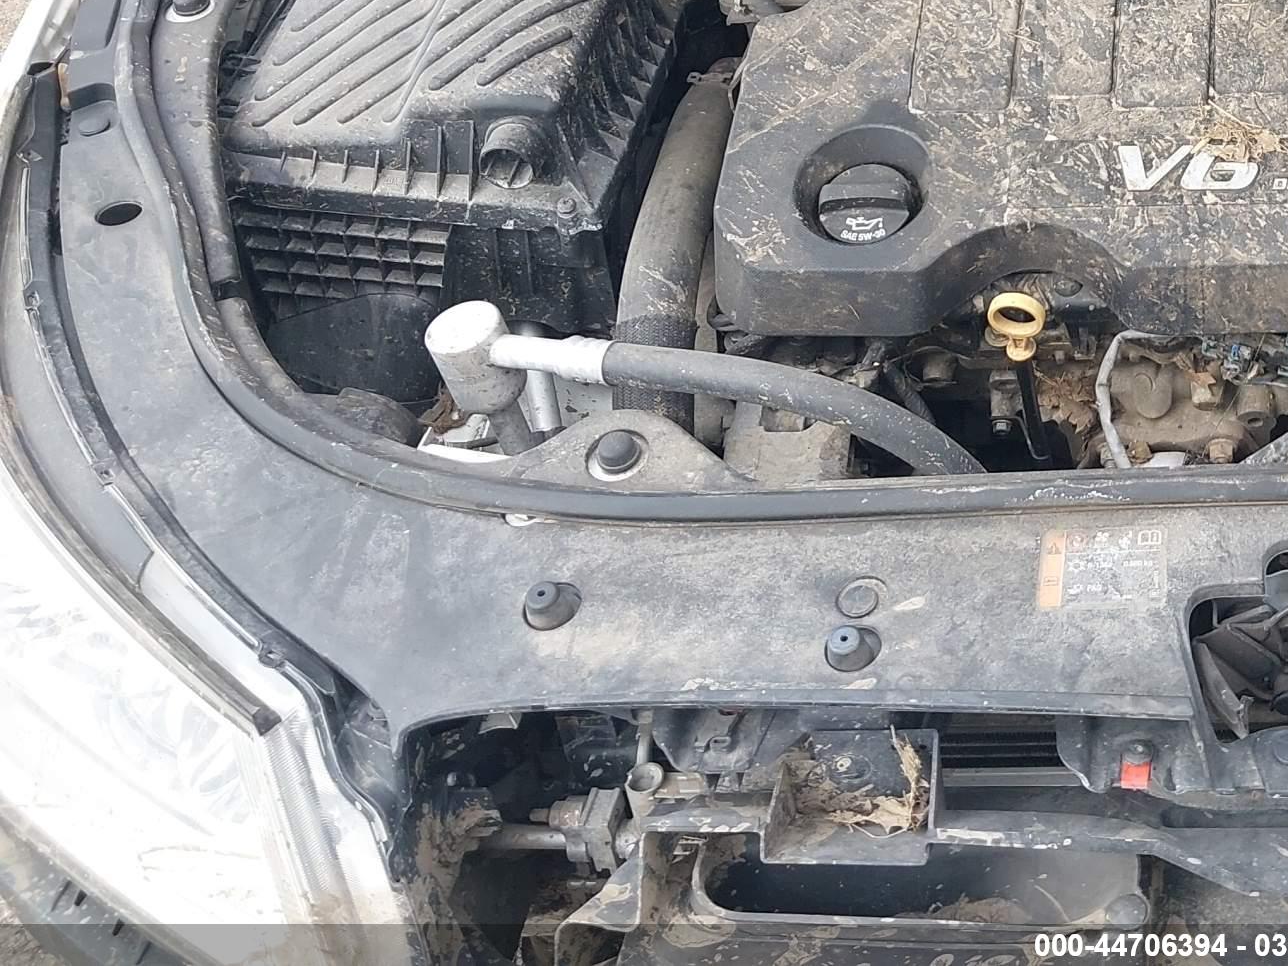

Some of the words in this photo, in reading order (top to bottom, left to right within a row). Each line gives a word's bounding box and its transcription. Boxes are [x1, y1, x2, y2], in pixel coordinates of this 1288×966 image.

[1118, 143, 1260, 191] V6
[840, 229, 858, 241] SAE
[857, 228, 886, 242] 5W-30
